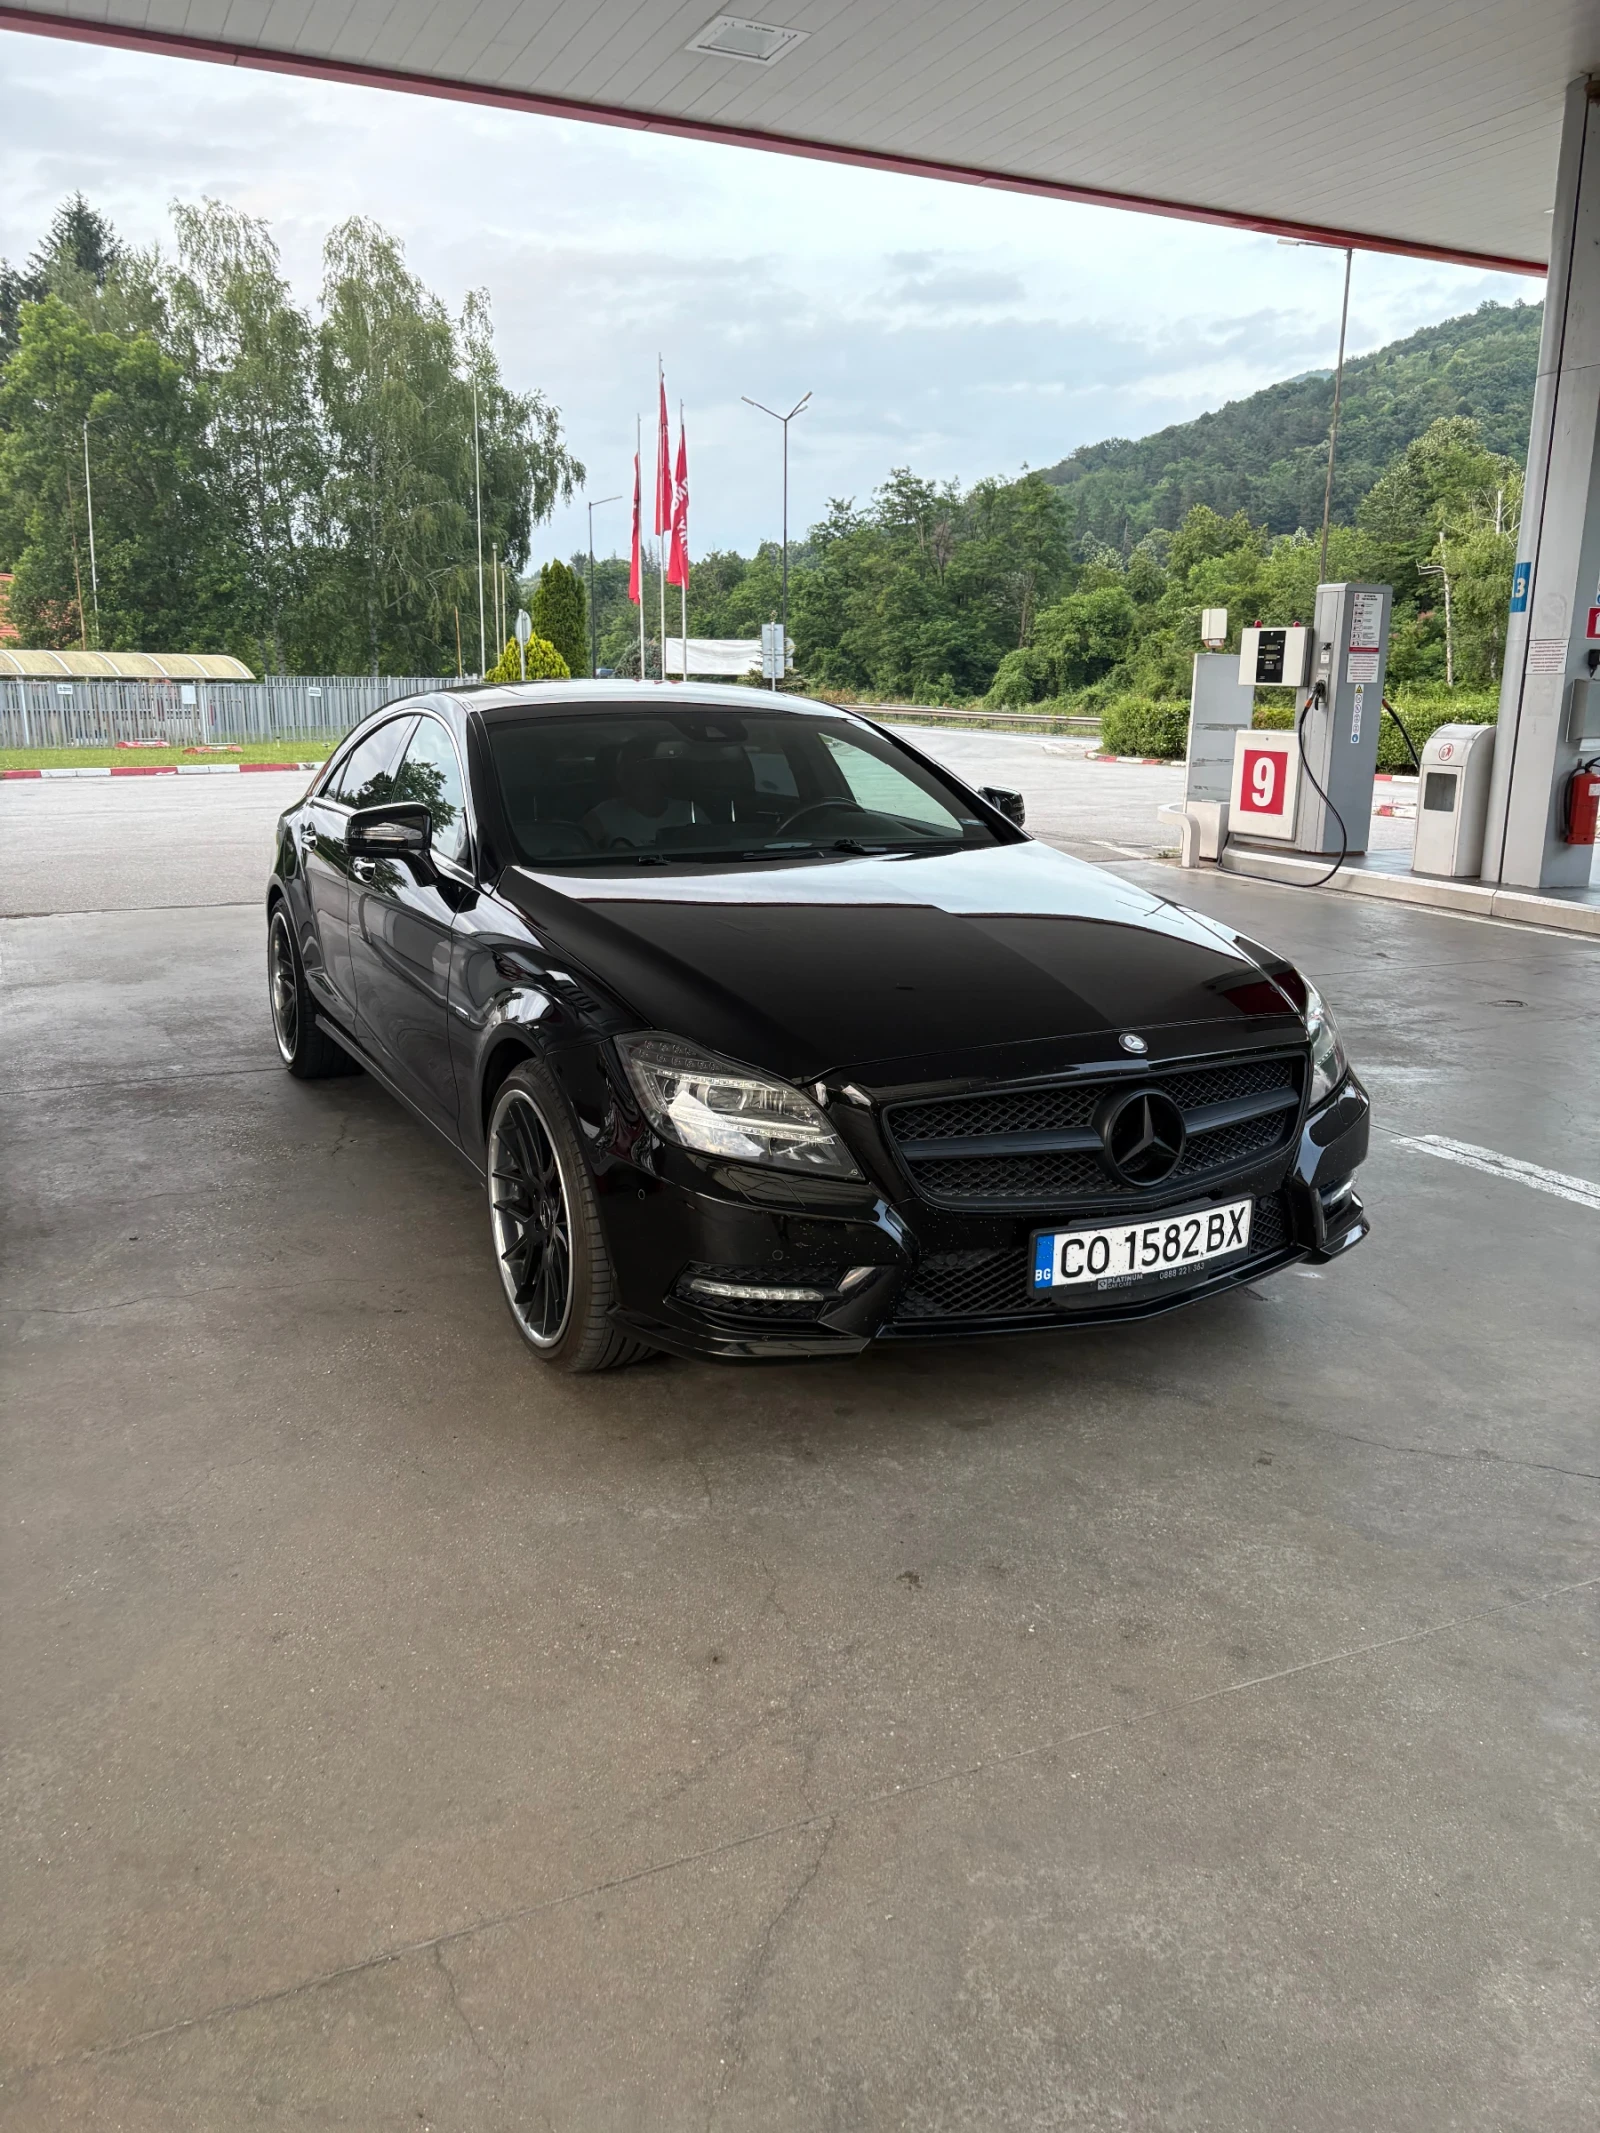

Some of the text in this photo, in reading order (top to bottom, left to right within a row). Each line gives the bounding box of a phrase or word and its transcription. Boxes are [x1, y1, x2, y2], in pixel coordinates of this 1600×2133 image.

[1252, 757, 1275, 807] 9
[1060, 1236, 1110, 1278] CO
[1124, 1219, 1201, 1270] 1582
[1035, 1269, 1051, 1282] BG
[1108, 1273, 1143, 1284] PLATINUM
